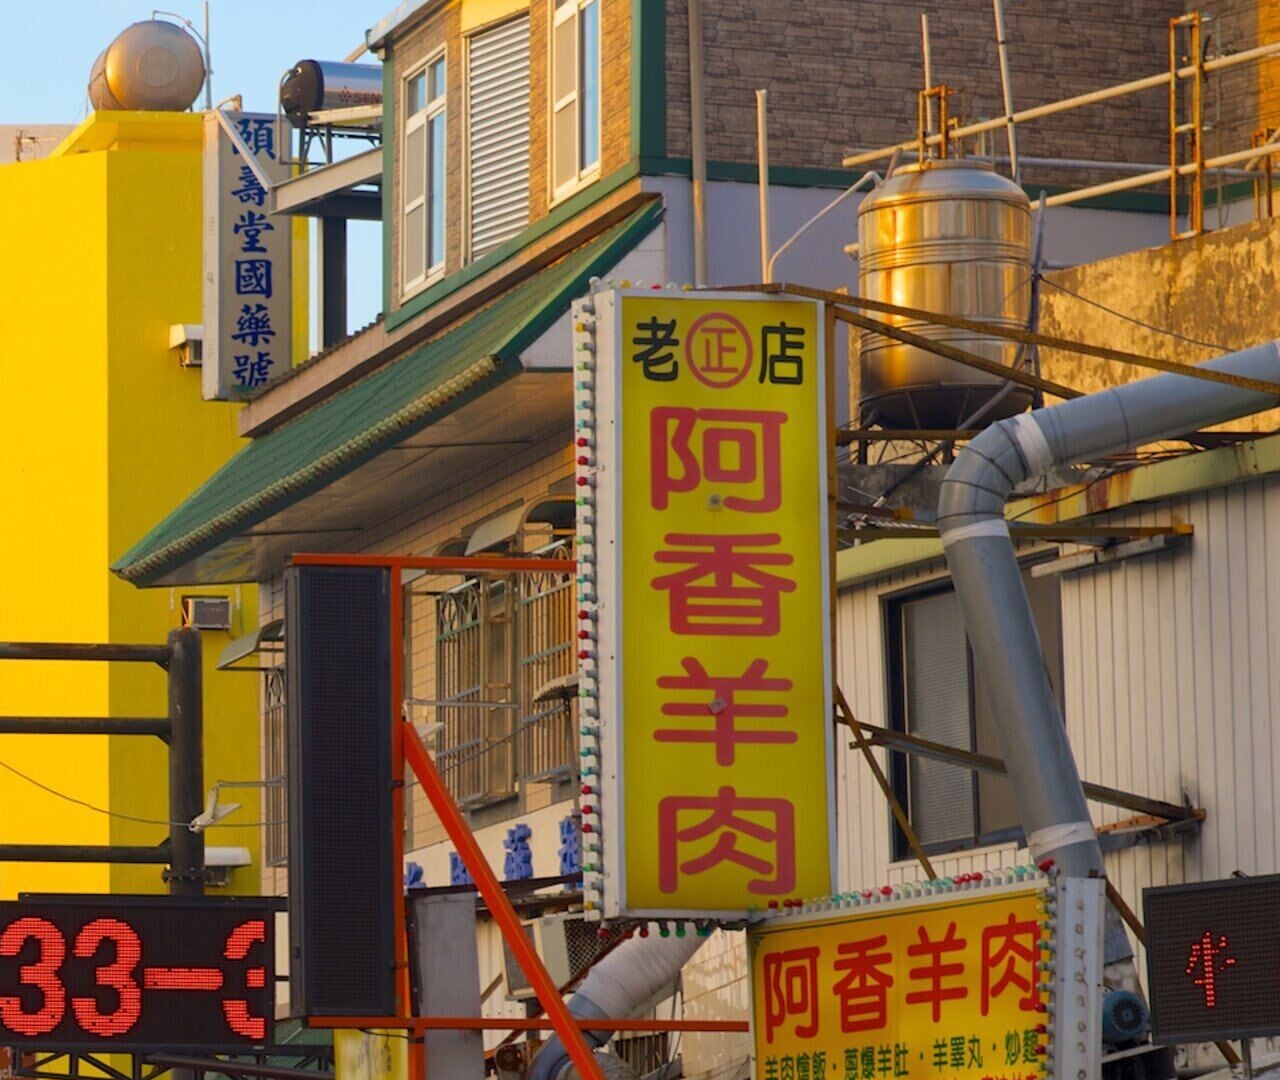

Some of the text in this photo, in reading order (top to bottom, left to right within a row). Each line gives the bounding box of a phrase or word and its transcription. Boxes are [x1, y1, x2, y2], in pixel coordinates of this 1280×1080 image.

[650, 405, 798, 896] 阿香羊肉
[762, 912, 1040, 1044] 阿香羊肉
